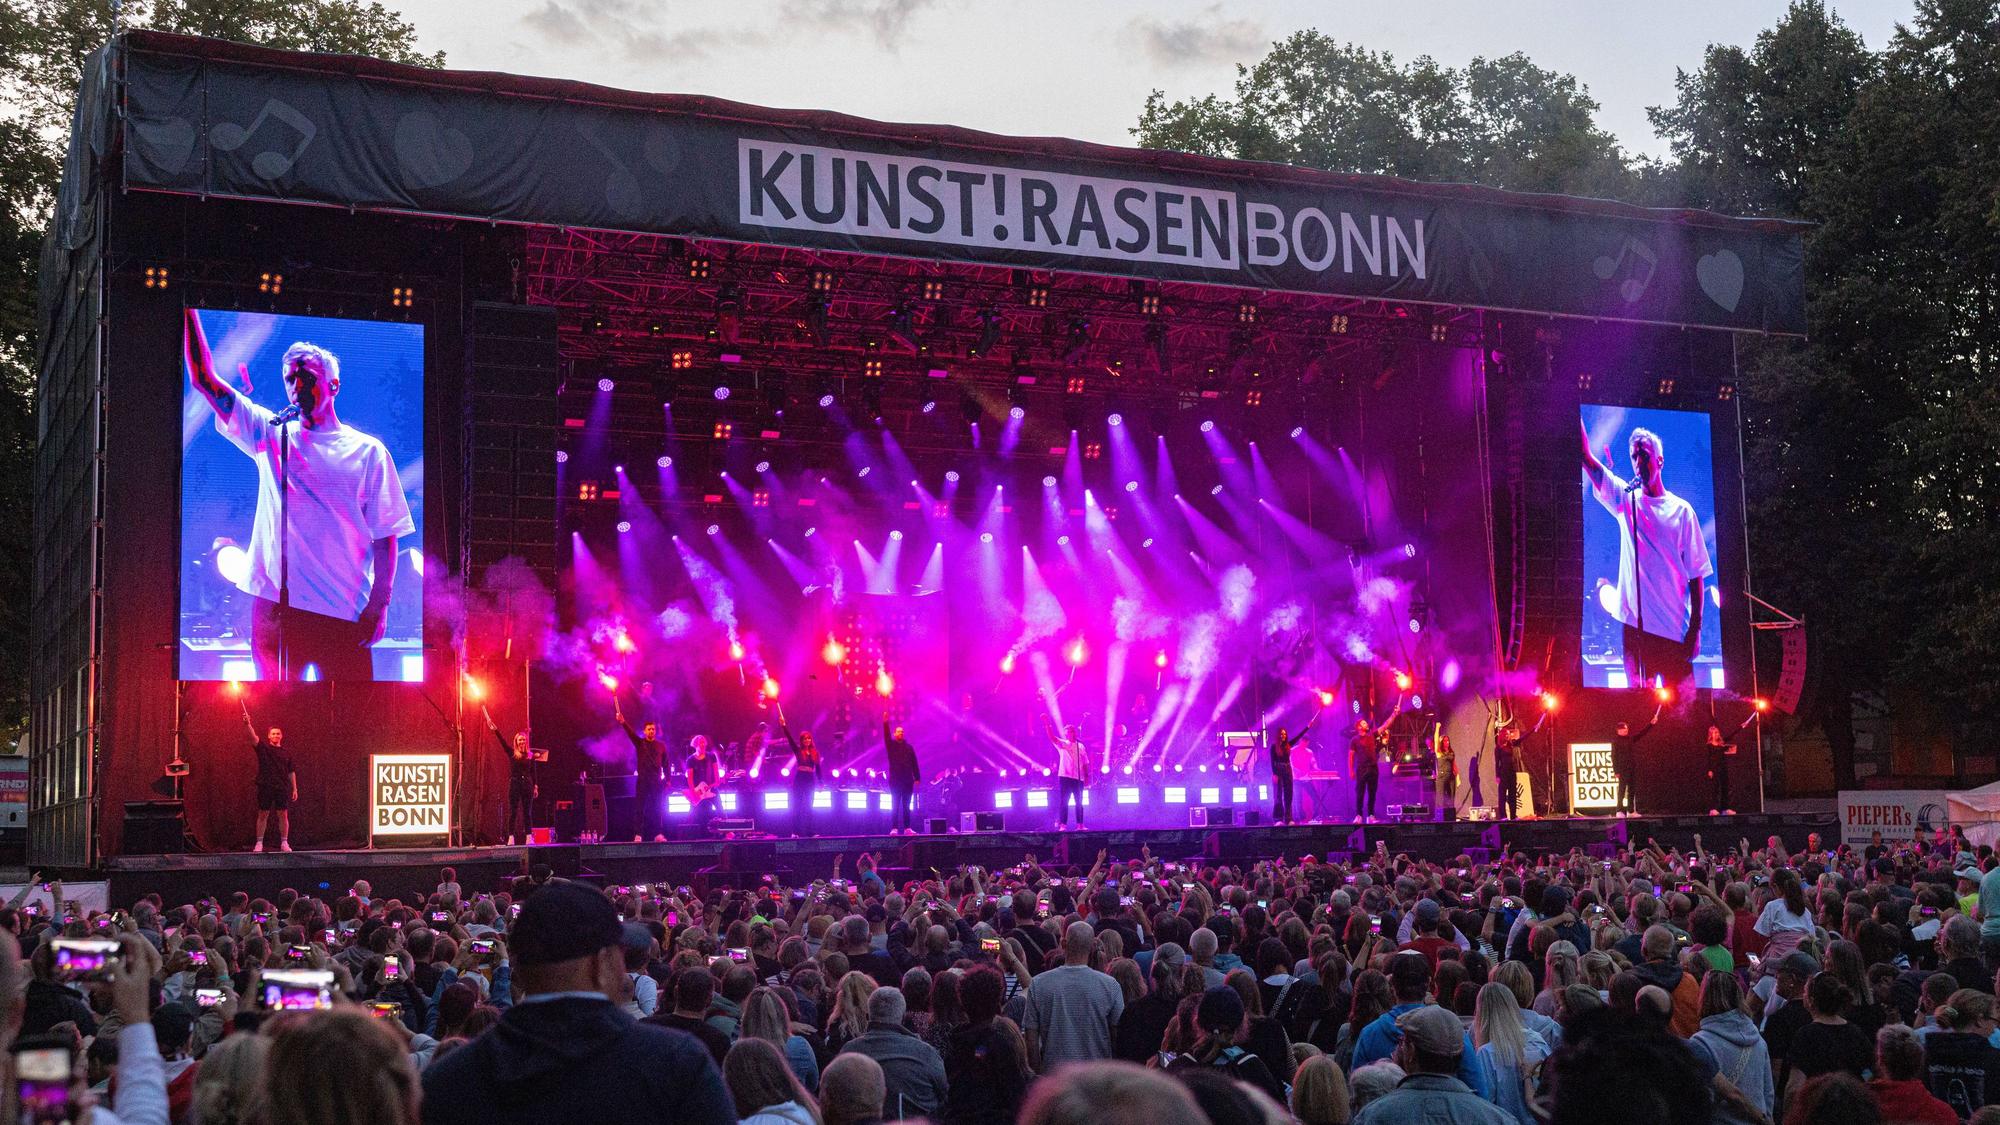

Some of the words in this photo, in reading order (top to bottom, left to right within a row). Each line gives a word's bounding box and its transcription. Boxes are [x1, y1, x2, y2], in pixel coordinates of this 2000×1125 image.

[1576, 752, 1613, 767] KUNS
[379, 765, 443, 783] KUNST!
[1580, 768, 1619, 783] RASE
[382, 785, 440, 803] RASEN
[1578, 786, 1618, 801] BON
[379, 808, 443, 826] BONN
